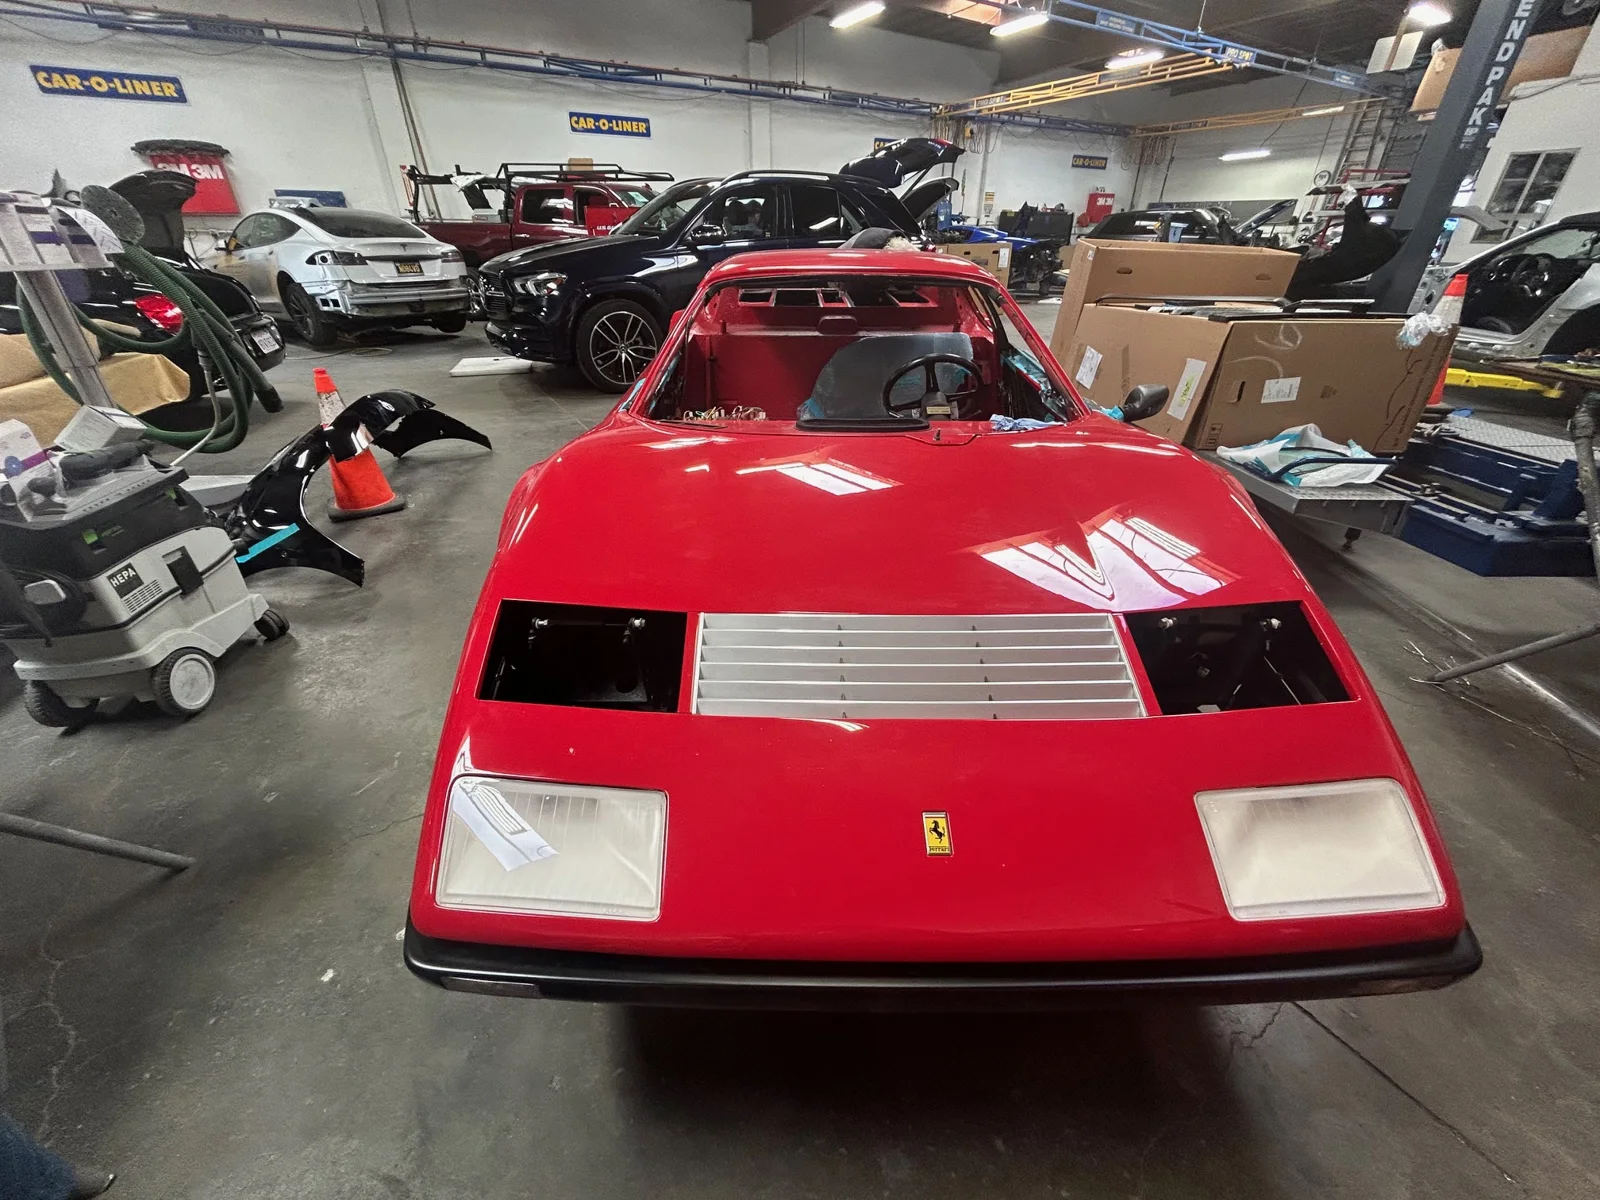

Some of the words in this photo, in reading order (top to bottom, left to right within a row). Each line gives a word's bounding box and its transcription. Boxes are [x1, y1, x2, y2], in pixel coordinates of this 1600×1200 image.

[1226, 46, 1239, 58] PRO
[36, 71, 180, 97] CAR-O-LINER
[570, 116, 647, 133] CAR-O-LINER
[190, 164, 224, 180] 3M
[110, 567, 136, 588] HEPA
